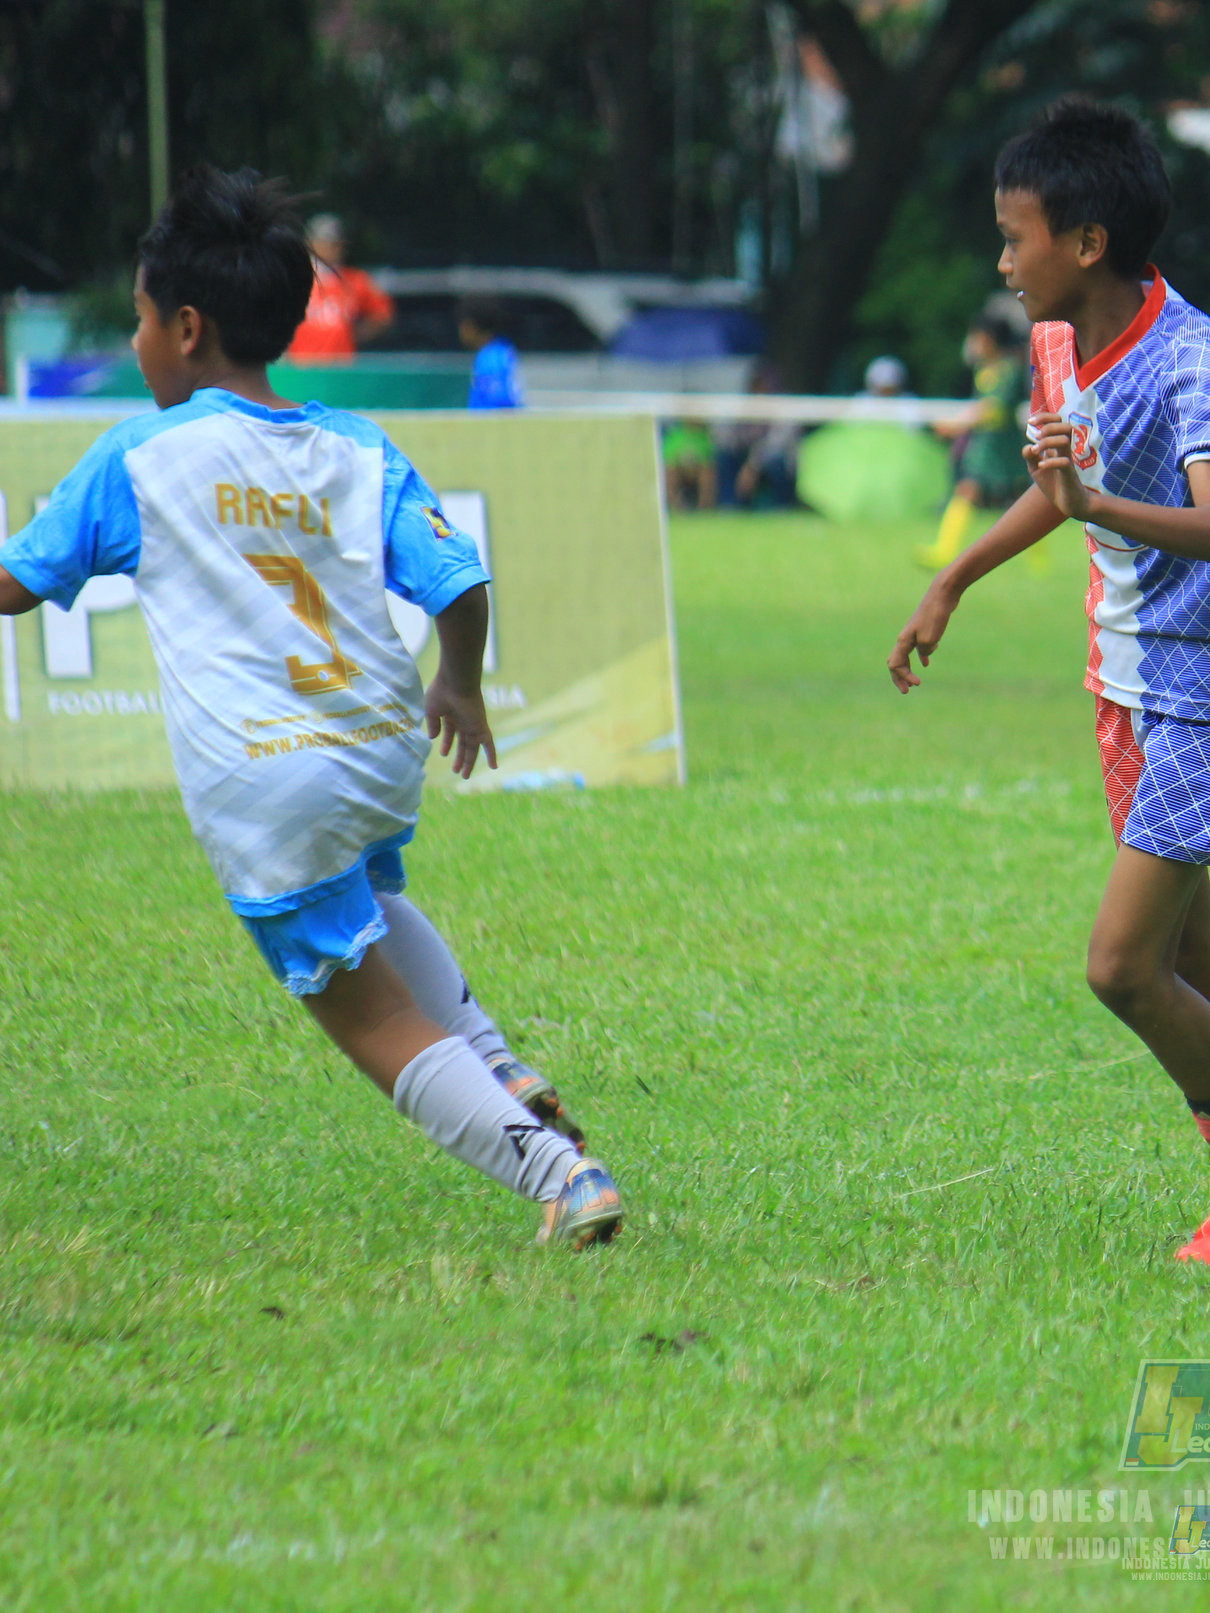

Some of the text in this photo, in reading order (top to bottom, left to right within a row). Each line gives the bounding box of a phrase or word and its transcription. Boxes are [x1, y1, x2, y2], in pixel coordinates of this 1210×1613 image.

[214, 483, 333, 537] RAFLI
[242, 554, 363, 695] 3
[47, 688, 162, 716] FOOTBAL
